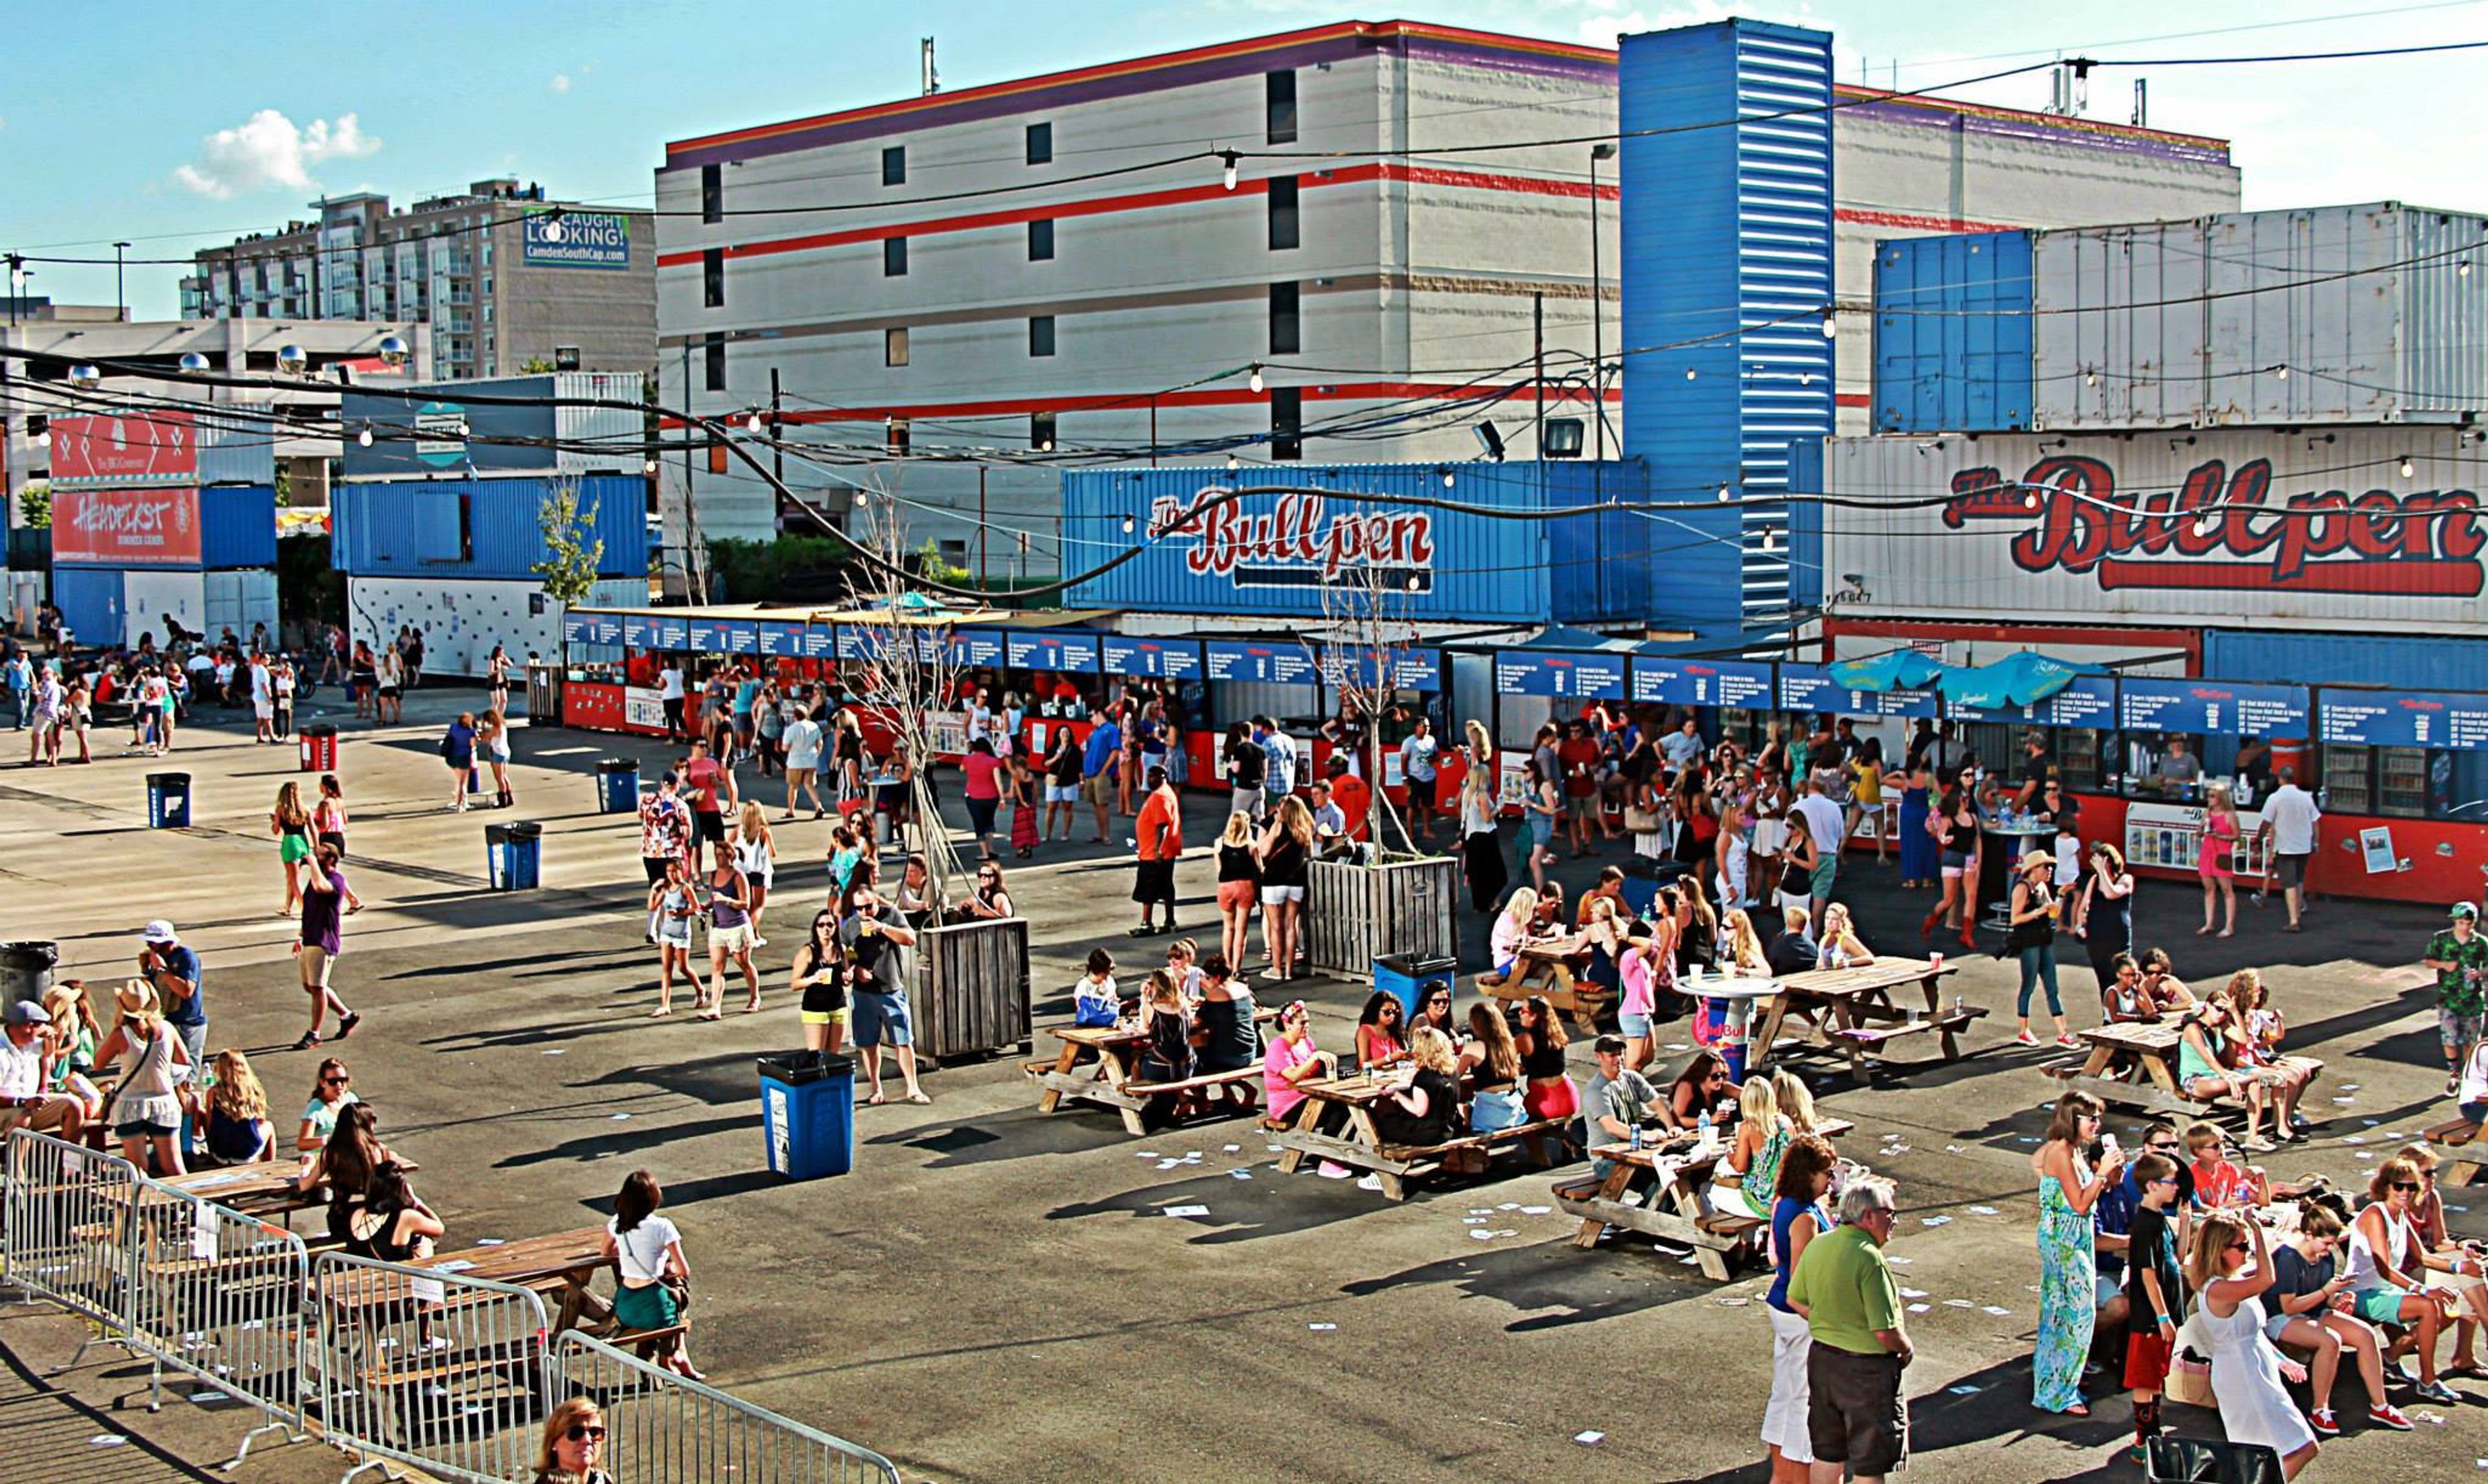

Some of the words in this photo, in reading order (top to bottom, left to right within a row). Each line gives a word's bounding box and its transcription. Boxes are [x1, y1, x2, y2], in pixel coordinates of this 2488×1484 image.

[561, 212, 622, 228] CAUGHT
[527, 225, 623, 246] LOOKING!
[527, 245, 625, 262] CamdenSouthCap.com
[2010, 455, 2488, 583] Bullpen
[1187, 487, 1434, 583] Bullpen
